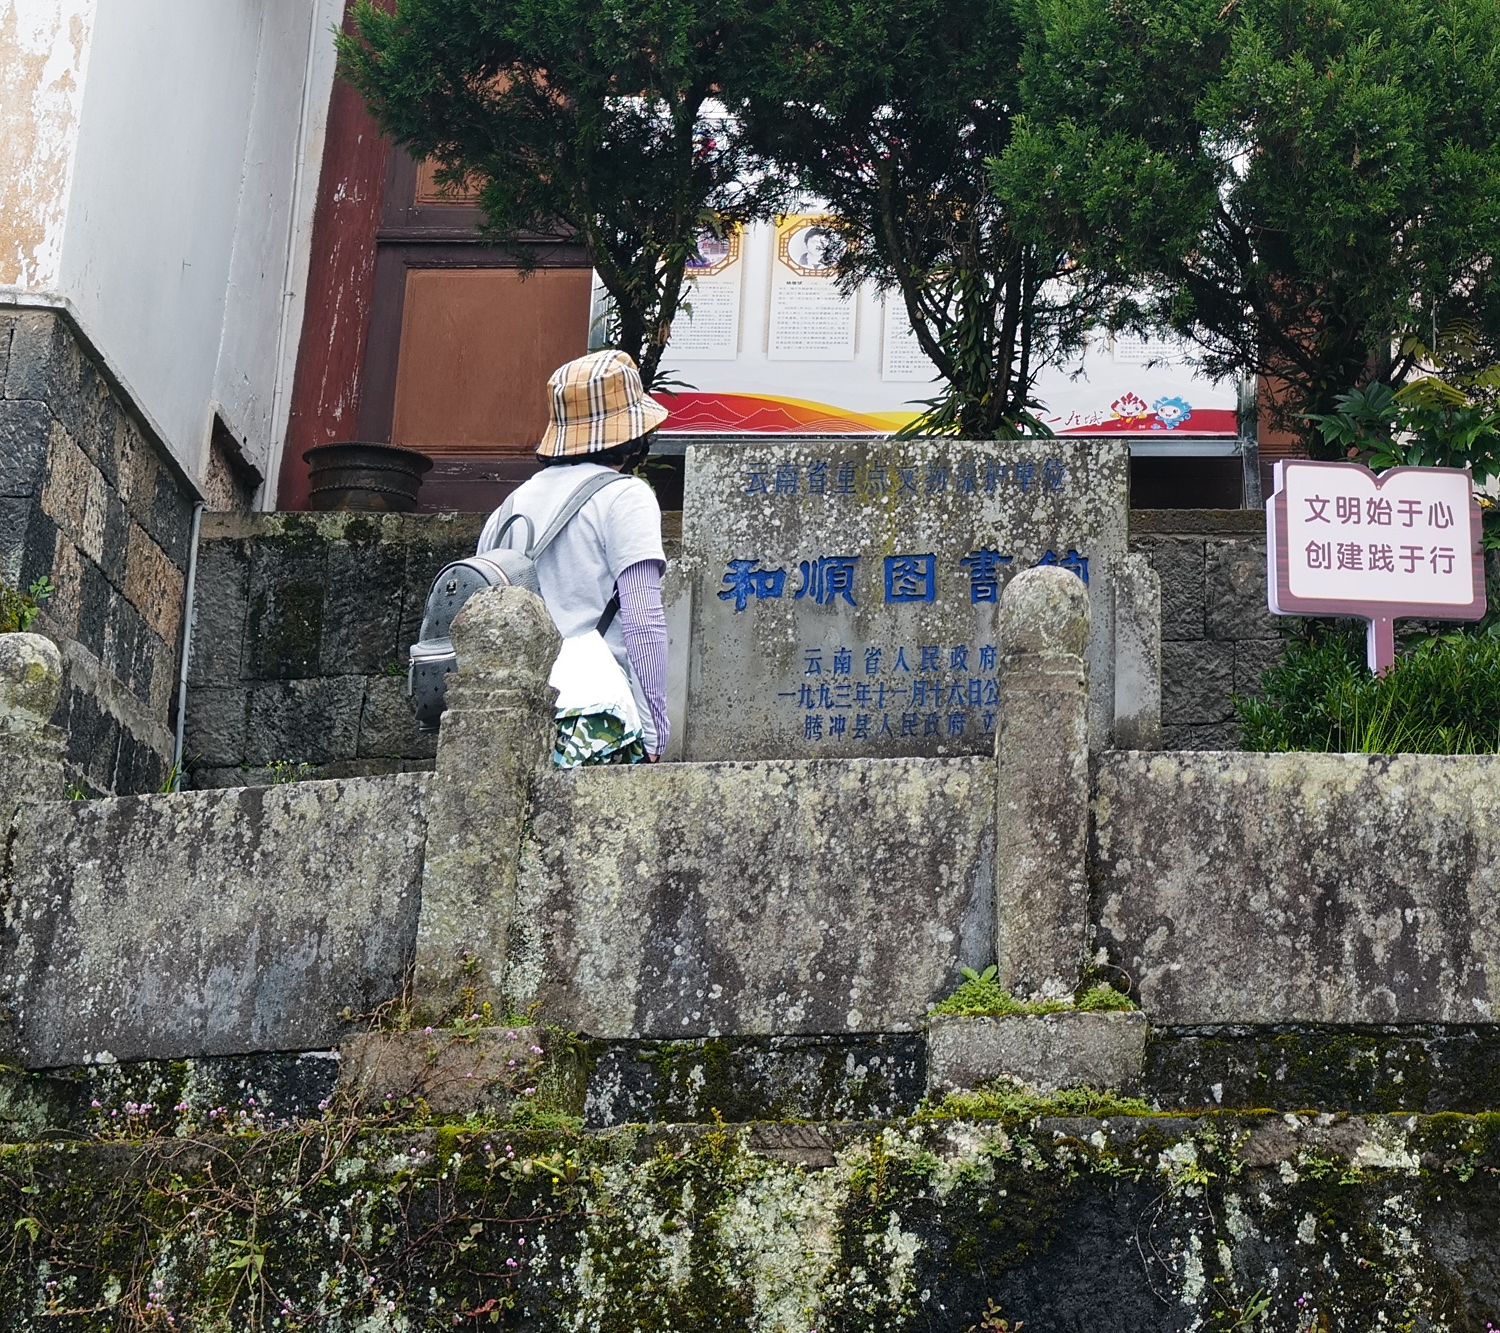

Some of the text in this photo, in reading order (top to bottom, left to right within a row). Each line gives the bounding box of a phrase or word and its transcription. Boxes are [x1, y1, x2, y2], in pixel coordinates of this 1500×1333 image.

[1304, 494, 1454, 529] 文明始于心
[1305, 540, 1456, 574] 创建践于行
[803, 644, 998, 676] 云南省人民政府
